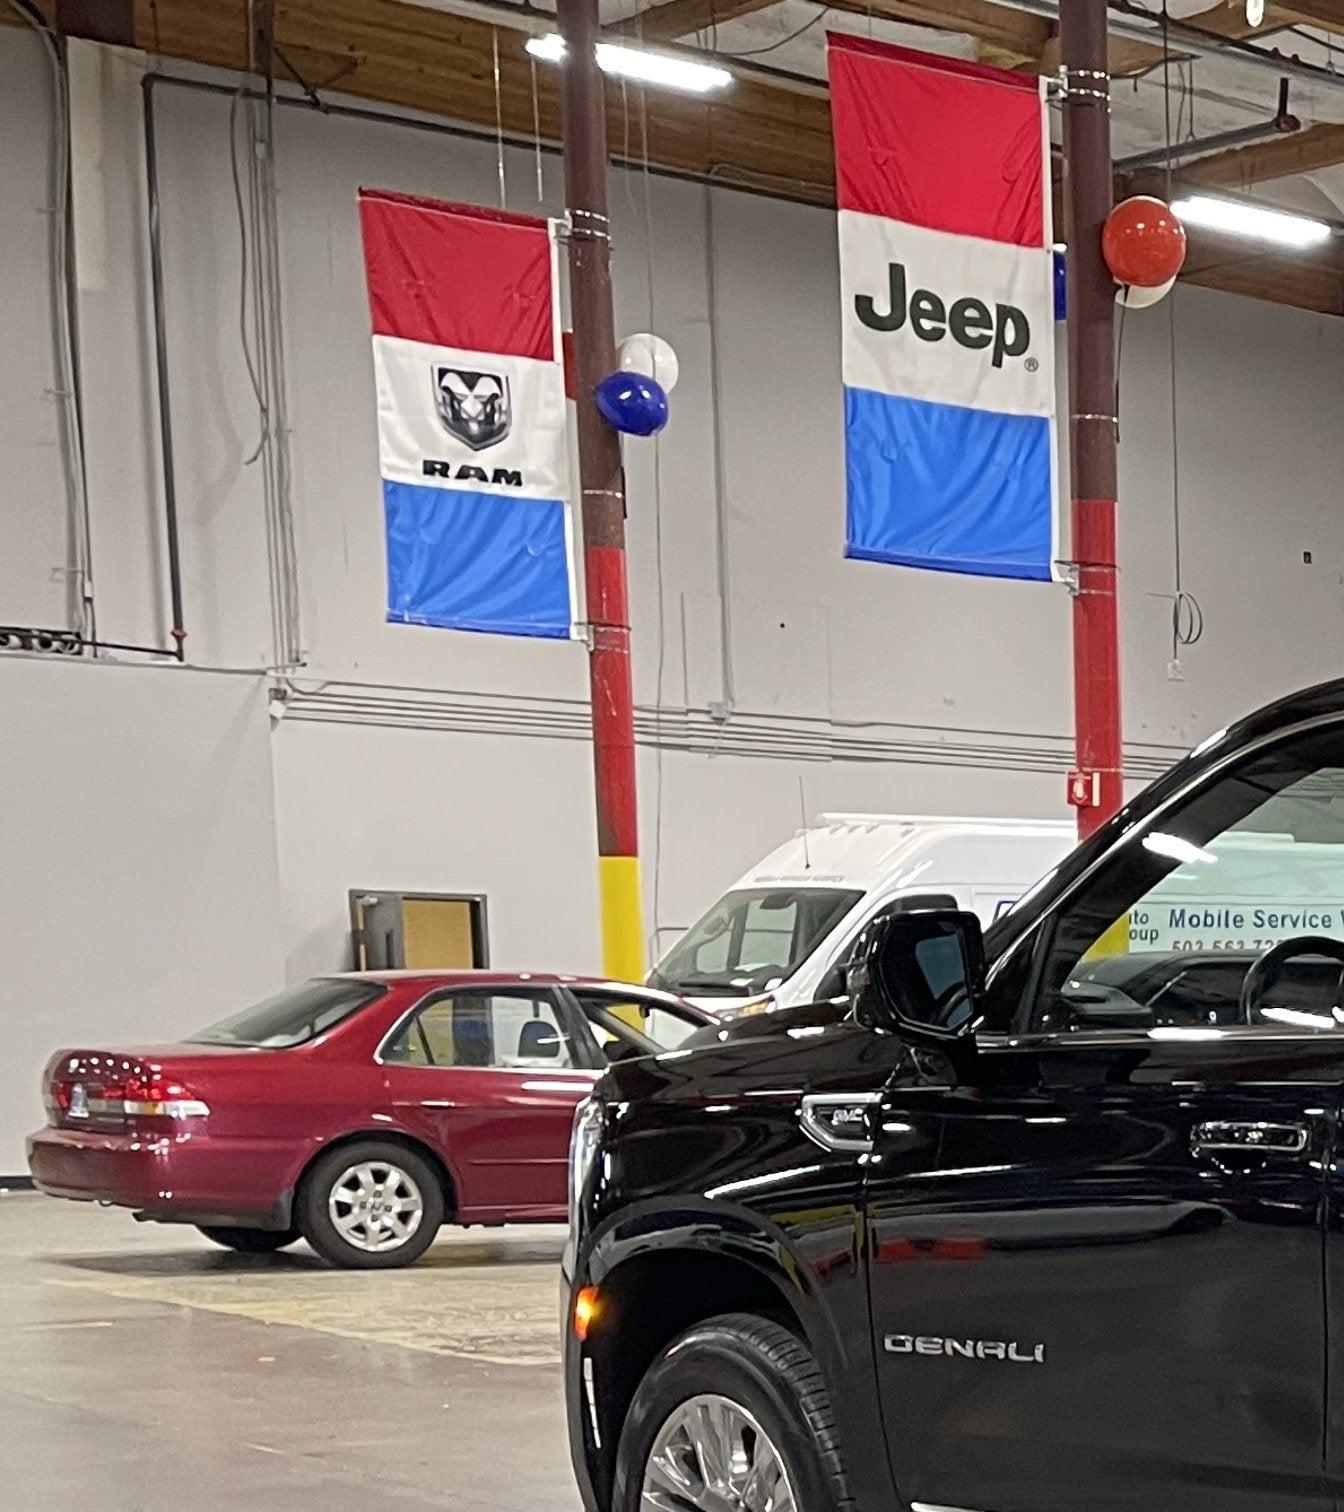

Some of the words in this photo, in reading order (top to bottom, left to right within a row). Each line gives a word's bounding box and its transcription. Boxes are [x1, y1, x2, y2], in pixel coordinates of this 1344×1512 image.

[855, 262, 1030, 368] Jeep
[423, 460, 522, 487] RAM
[1169, 909, 1244, 929] Mobile
[1253, 909, 1332, 929] Service
[884, 1334, 1044, 1363] DENALI
